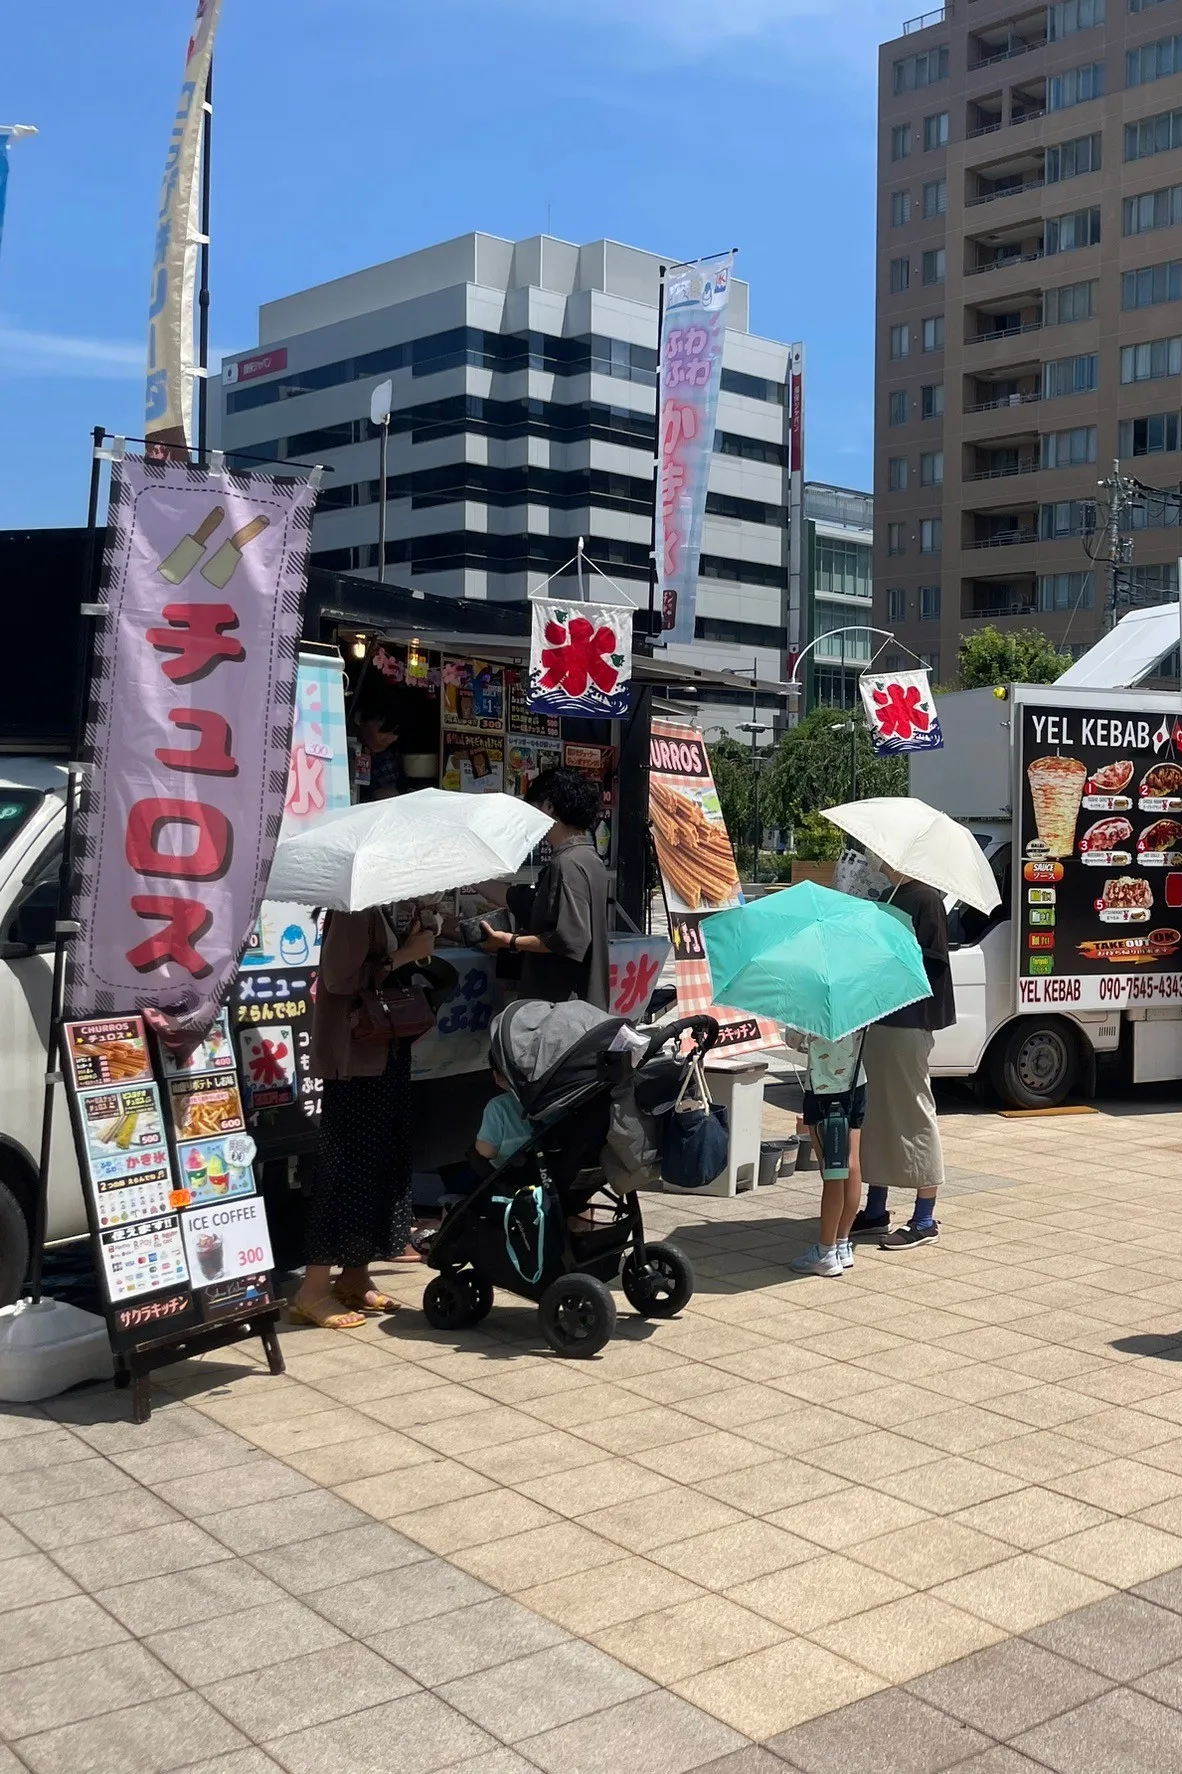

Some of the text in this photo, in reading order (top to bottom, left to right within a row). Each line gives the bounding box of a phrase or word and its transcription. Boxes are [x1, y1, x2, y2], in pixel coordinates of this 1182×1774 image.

[539, 617, 619, 697] 氷
[873, 683, 930, 739] 氷
[481, 720, 503, 730] 300
[1031, 715, 1150, 749] YEL KEBAB
[124, 603, 247, 980] チュロス
[1141, 785, 1148, 796] 2
[1080, 840, 1088, 851] 3
[1138, 840, 1146, 851] 4
[1032, 863, 1055, 872] SAUCE
[1032, 872, 1056, 880] ソース
[1096, 899, 1104, 910] 5
[1153, 931, 1176, 942] OK
[1093, 938, 1150, 950] TAKE OUT
[239, 975, 307, 1001] メニュー
[1020, 979, 1041, 1003] YEL
[1043, 978, 1081, 1002] KEBAB
[80, 1022, 130, 1035] CHURROS
[715, 1023, 757, 1044] ラキッチン
[87, 1031, 126, 1043] チュロス
[214, 1057, 232, 1067] 400
[249, 1038, 289, 1086] 氷
[221, 1118, 241, 1129] 600
[141, 1134, 159, 1144] 500
[125, 1150, 167, 1169] かき氷
[188, 1205, 257, 1233] ICE COFFEE
[237, 1246, 265, 1267] 300
[120, 1295, 189, 1328] サクラキッチン
